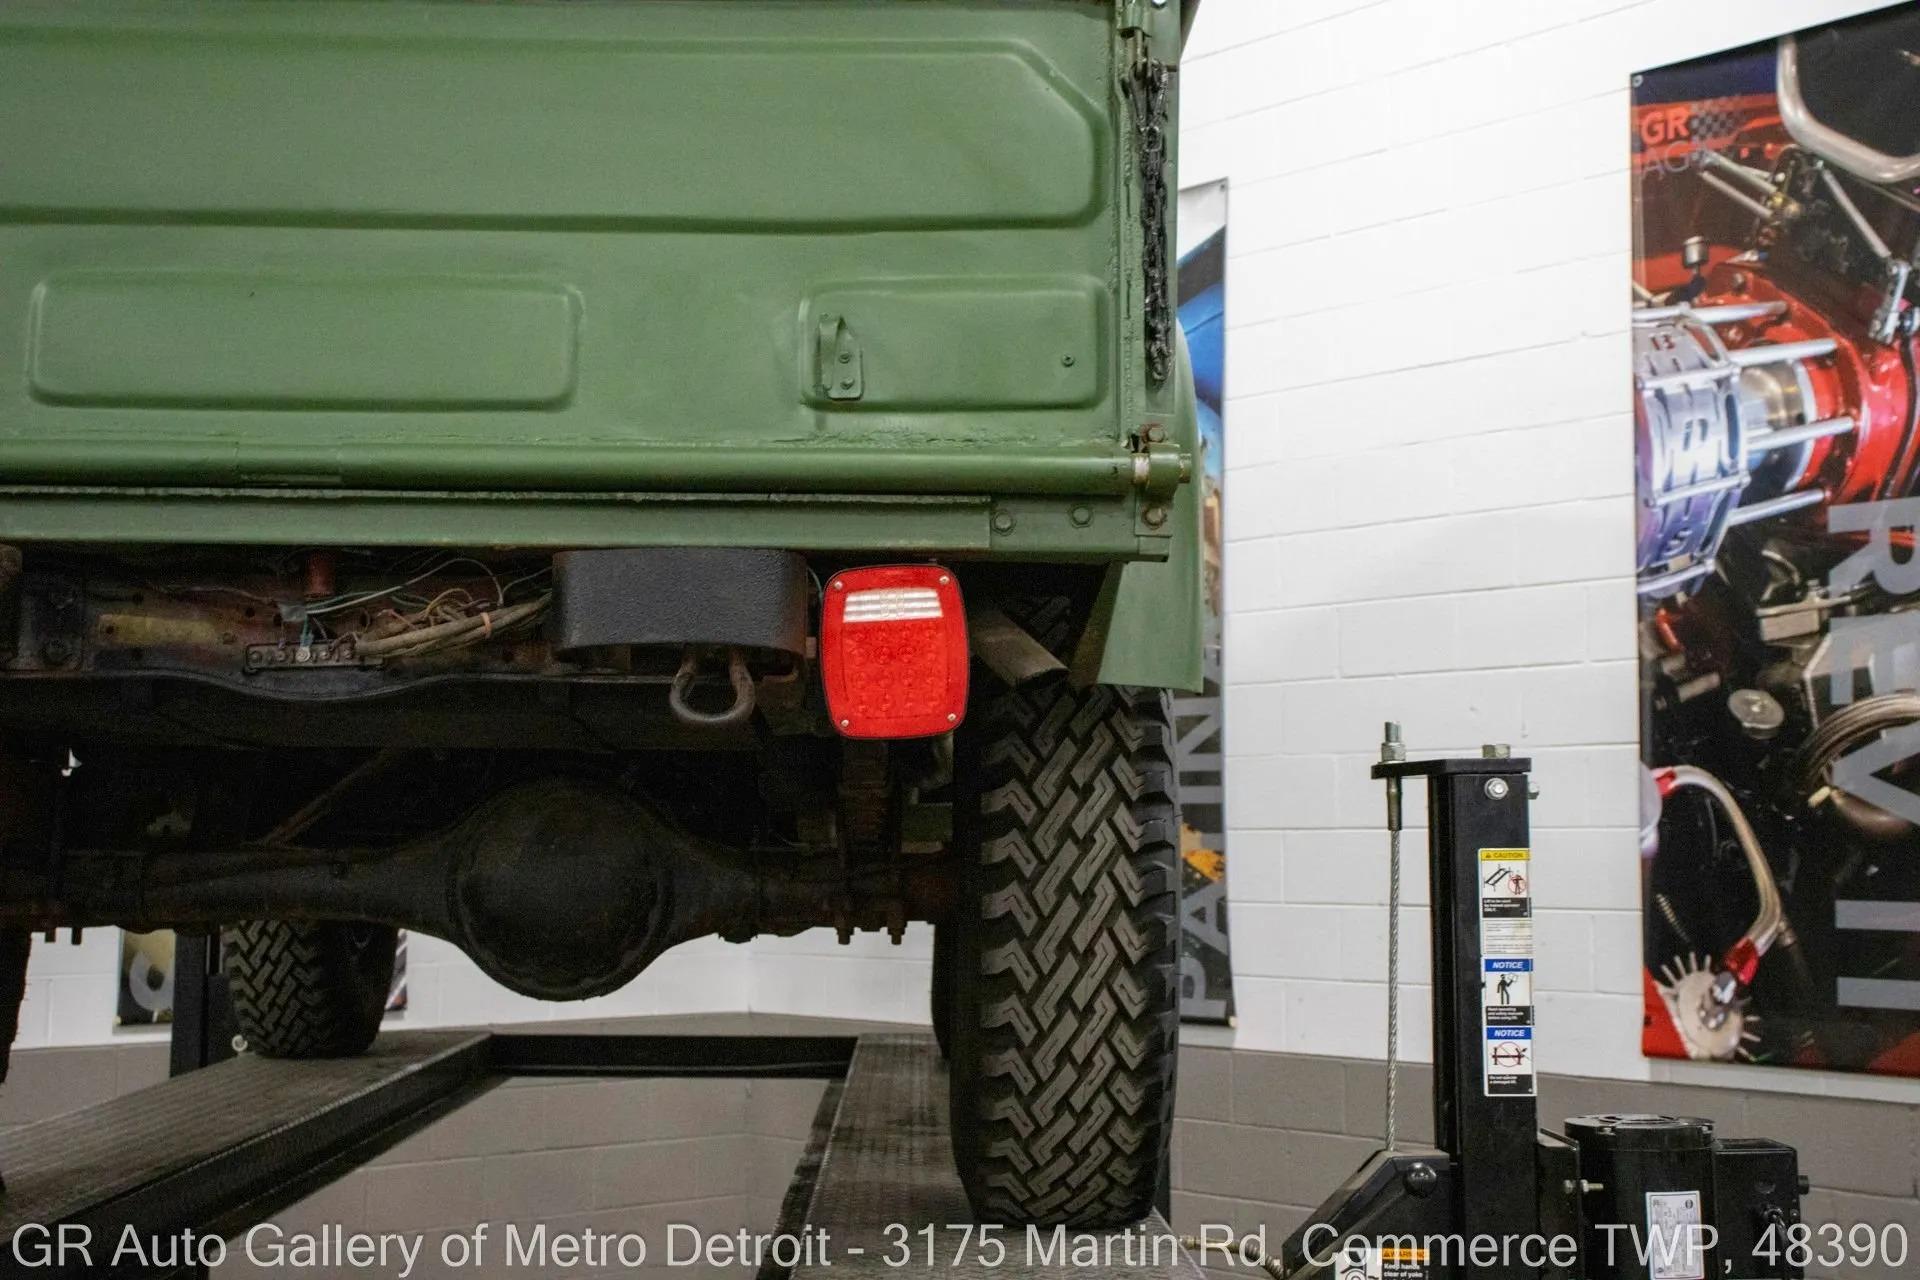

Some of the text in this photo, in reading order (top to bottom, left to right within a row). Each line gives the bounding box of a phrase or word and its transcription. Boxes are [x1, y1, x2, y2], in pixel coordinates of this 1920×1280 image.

[1641, 106, 1690, 145] GR
[1492, 961, 1524, 969] NOTICE
[1494, 1029, 1526, 1037] NOTICE
